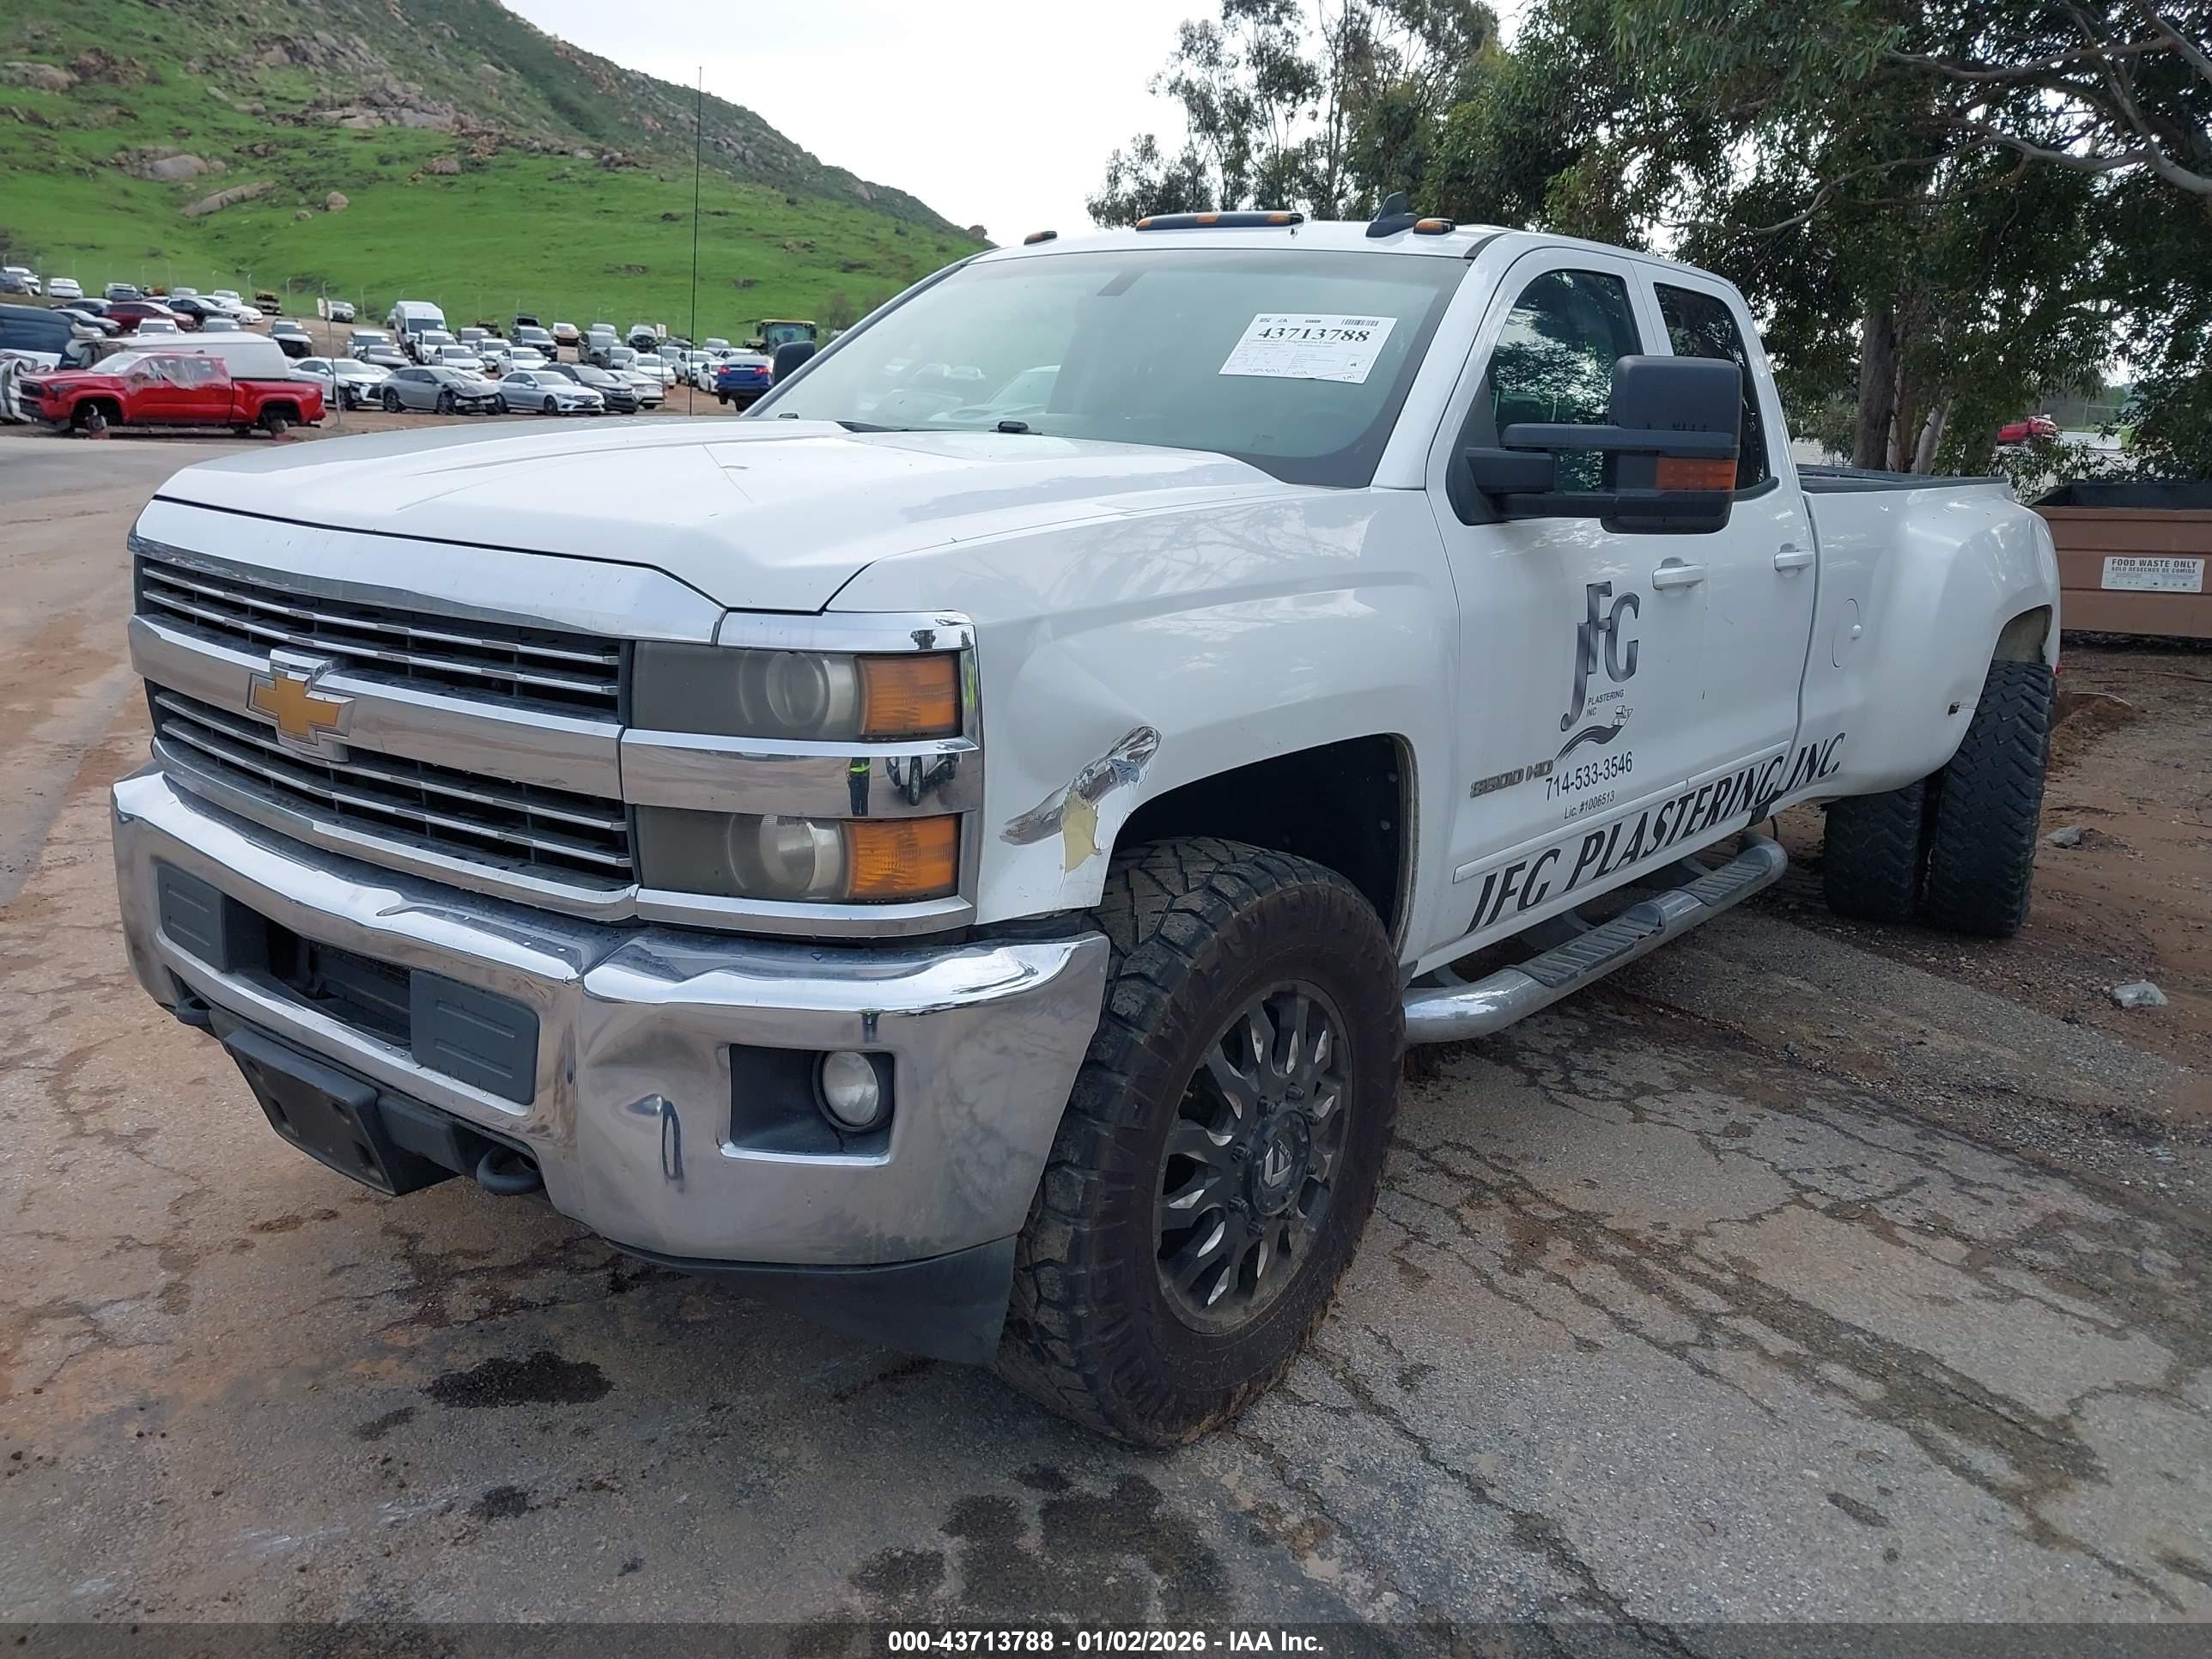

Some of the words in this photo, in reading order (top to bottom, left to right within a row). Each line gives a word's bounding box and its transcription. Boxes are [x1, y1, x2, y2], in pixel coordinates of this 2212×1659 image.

[1257, 327, 1370, 343] 43713788
[2112, 558, 2136, 567] FOOD
[2139, 559, 2171, 568] WASTE
[2173, 560, 2197, 568] ONLY
[1587, 689, 1625, 706] PLASTERING
[1586, 707, 1597, 718] INC
[1545, 750, 1633, 801] 714-533-3546
[1563, 755, 1784, 895] PLASTERING
[1785, 732, 1844, 792] INC.
[1564, 805, 1577, 820] Lic.
[1579, 790, 1615, 814] #1006513
